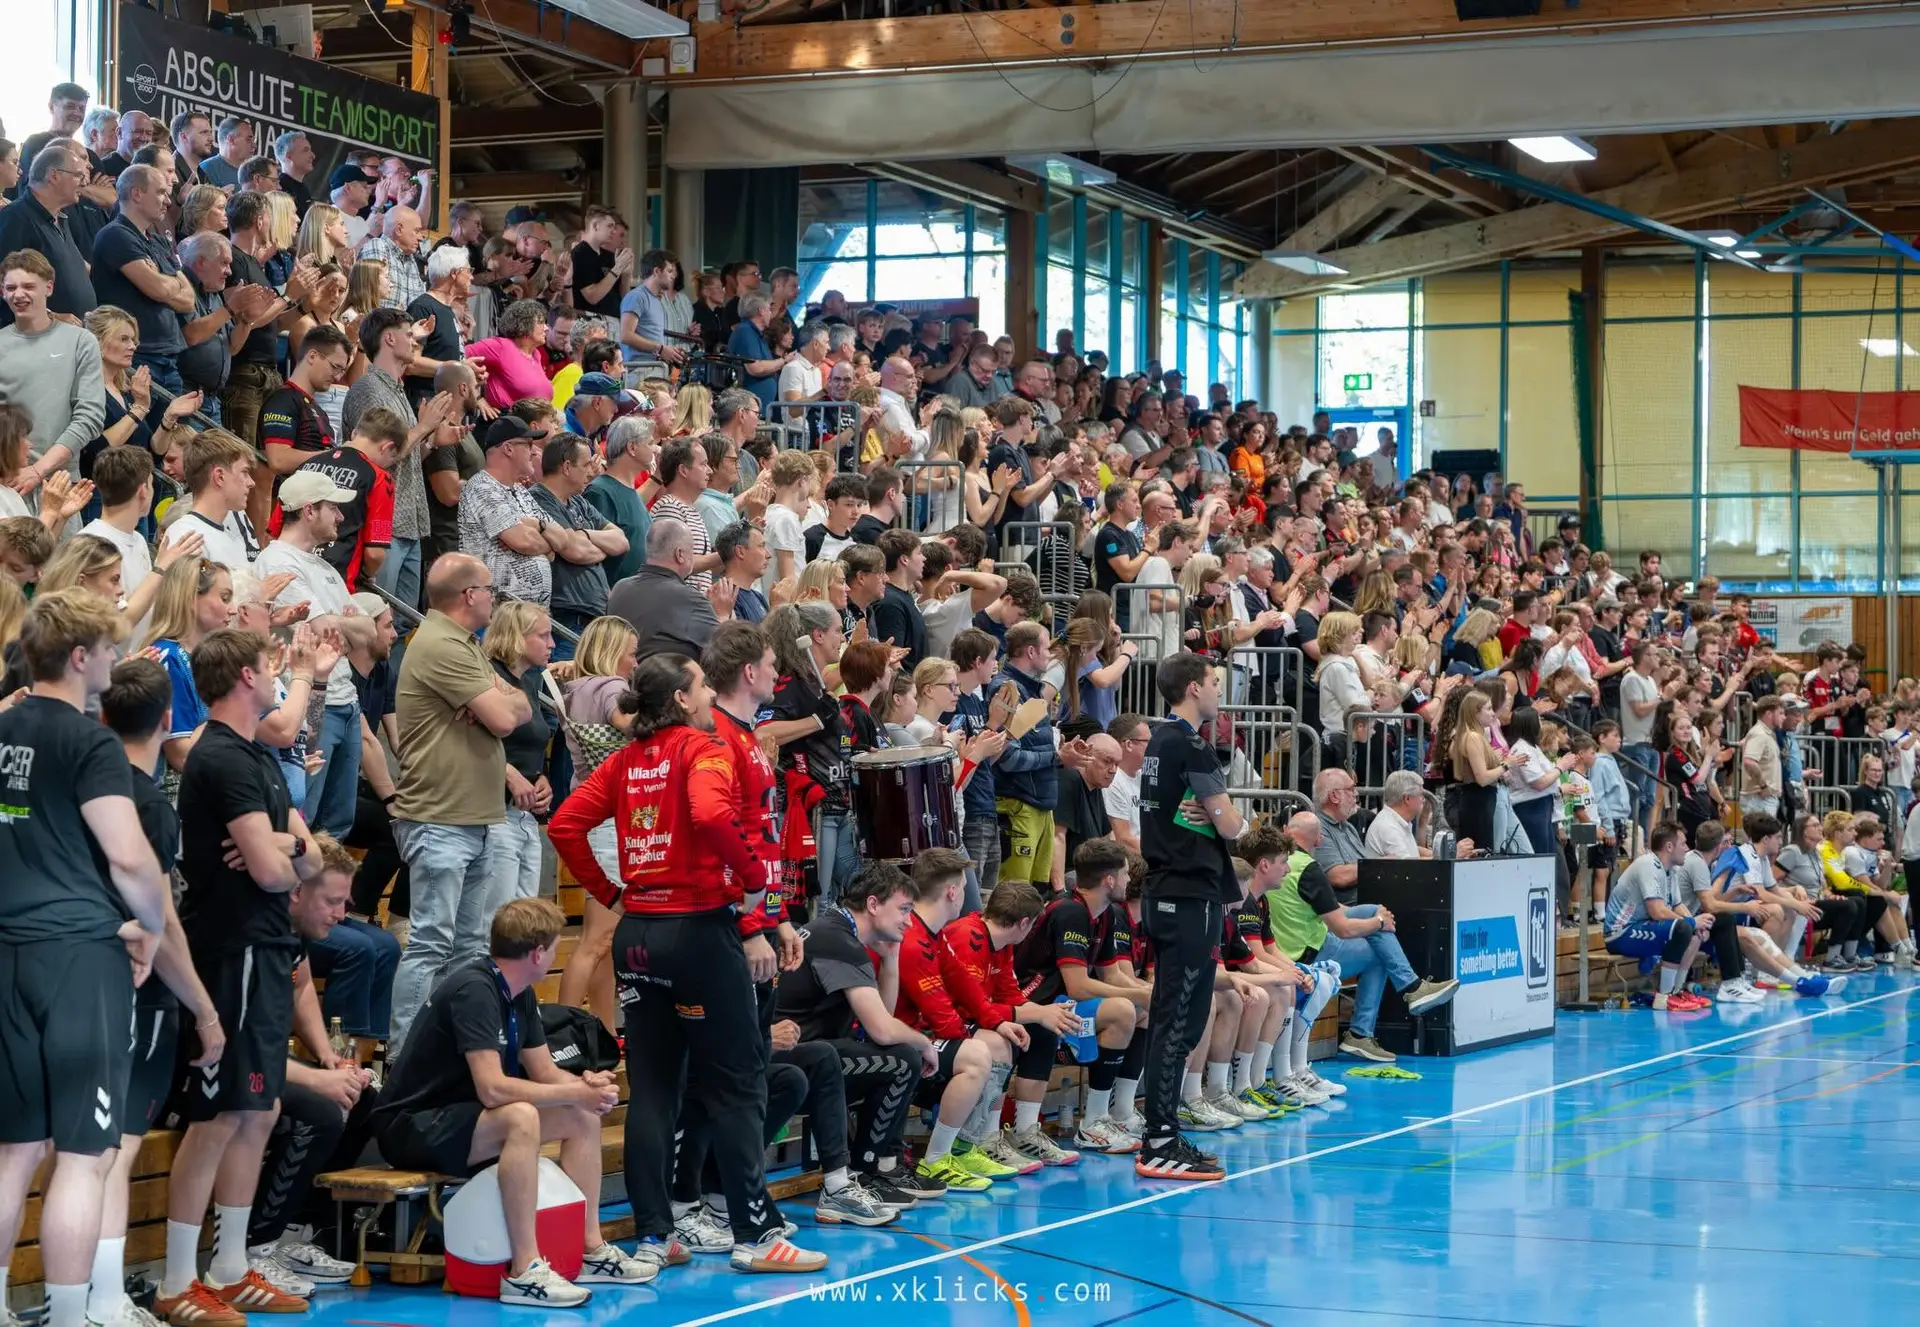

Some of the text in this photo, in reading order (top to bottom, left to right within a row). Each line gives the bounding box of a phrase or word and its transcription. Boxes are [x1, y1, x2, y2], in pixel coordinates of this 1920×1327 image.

[135, 72, 157, 85] SPORT
[136, 83, 153, 94] 2000
[164, 46, 296, 121] ABSOLUTE
[298, 84, 436, 159] TEAMSPORT
[263, 412, 293, 424] Dimax
[1859, 428, 1891, 442] Geld
[1894, 428, 1920, 444] geh
[1460, 925, 1488, 949] time for
[1460, 947, 1519, 976] something better
